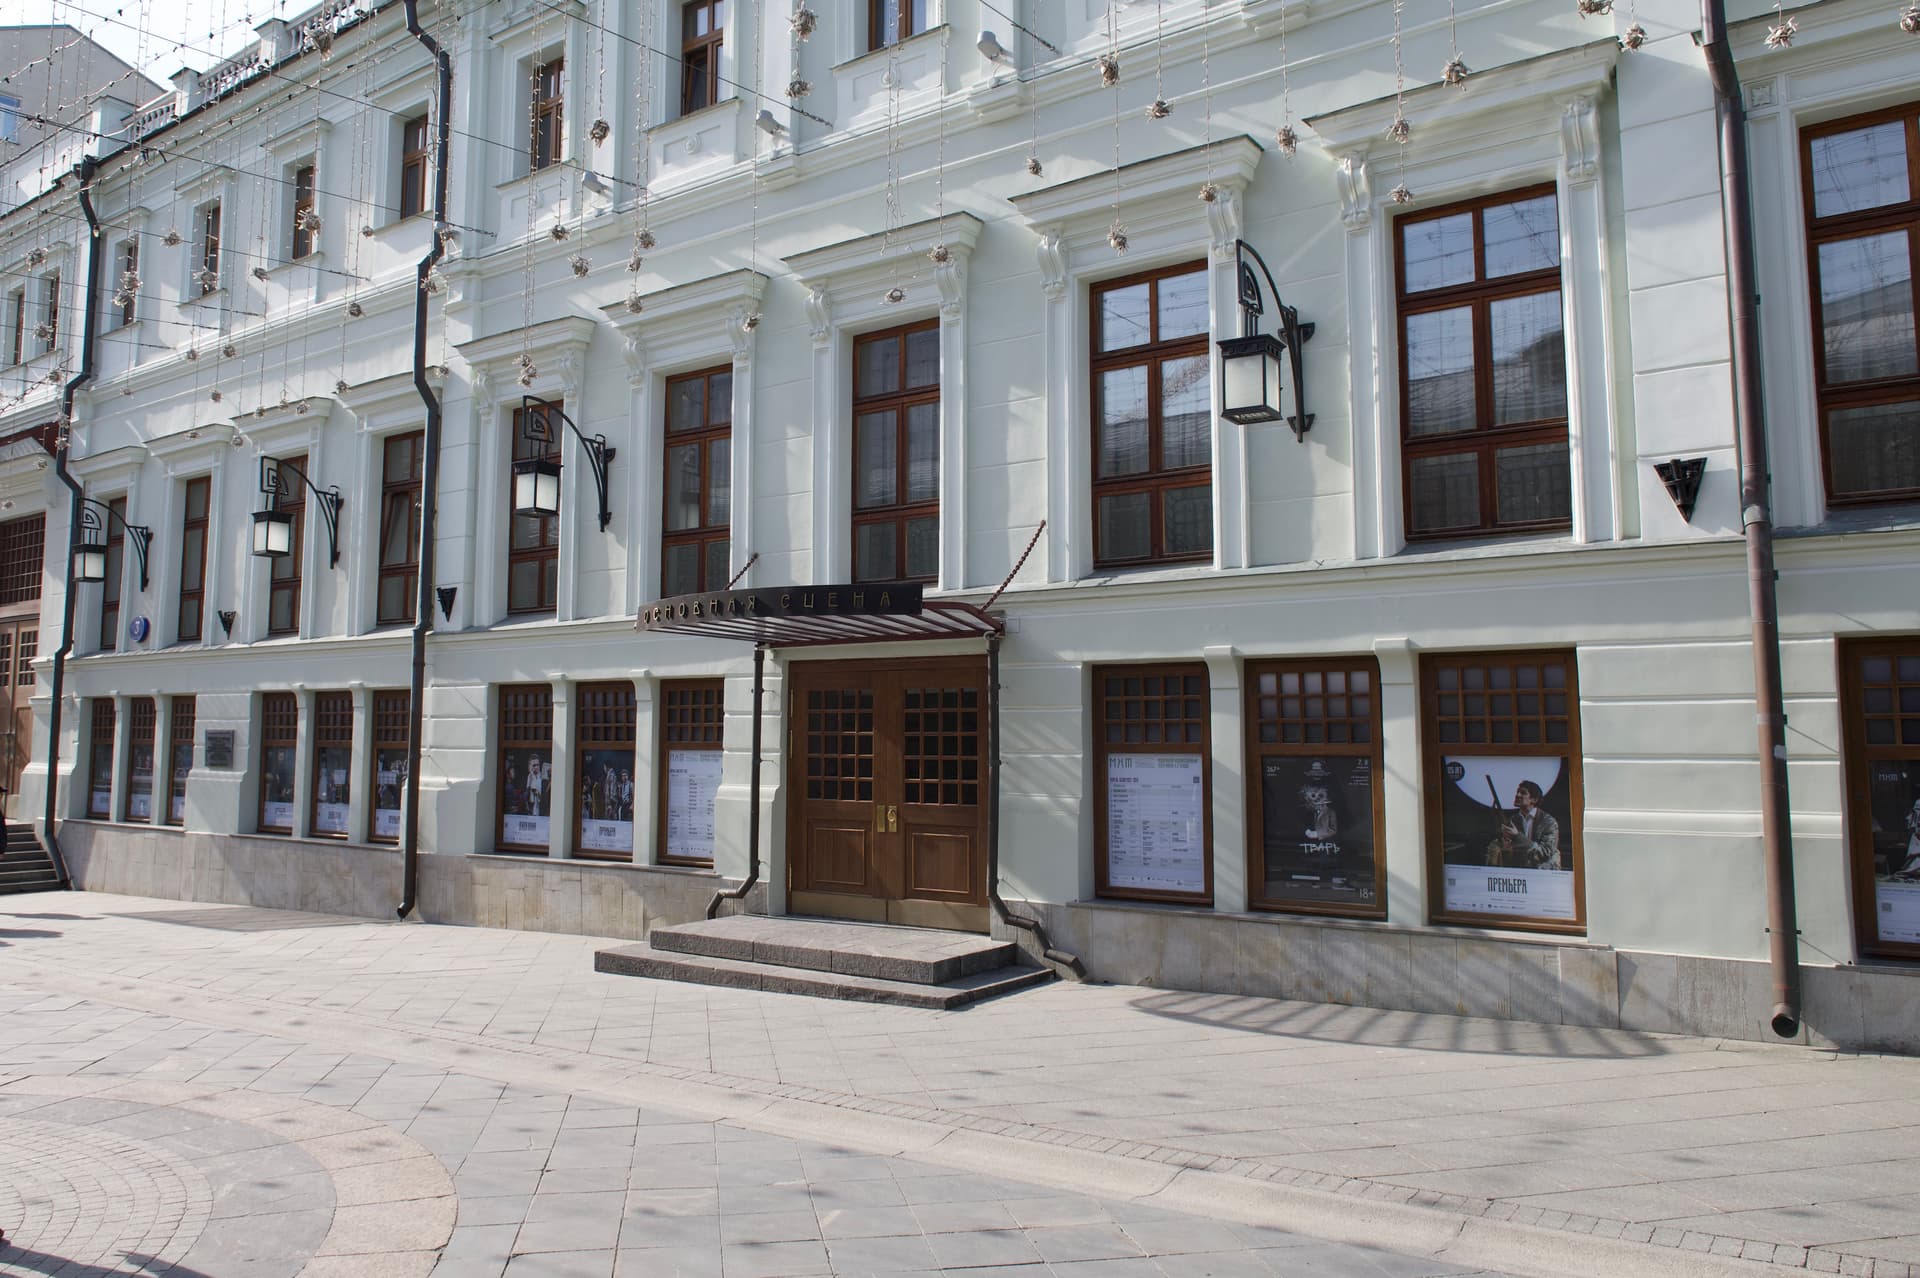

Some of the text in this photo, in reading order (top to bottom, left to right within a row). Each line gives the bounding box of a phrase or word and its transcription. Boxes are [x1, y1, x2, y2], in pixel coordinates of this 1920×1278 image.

[643, 591, 892, 624] ОСНОВНАЯ СЦЕНА
[1359, 887, 1376, 899] 18+
[1487, 877, 1528, 895] ПРЕМЬЕРА
